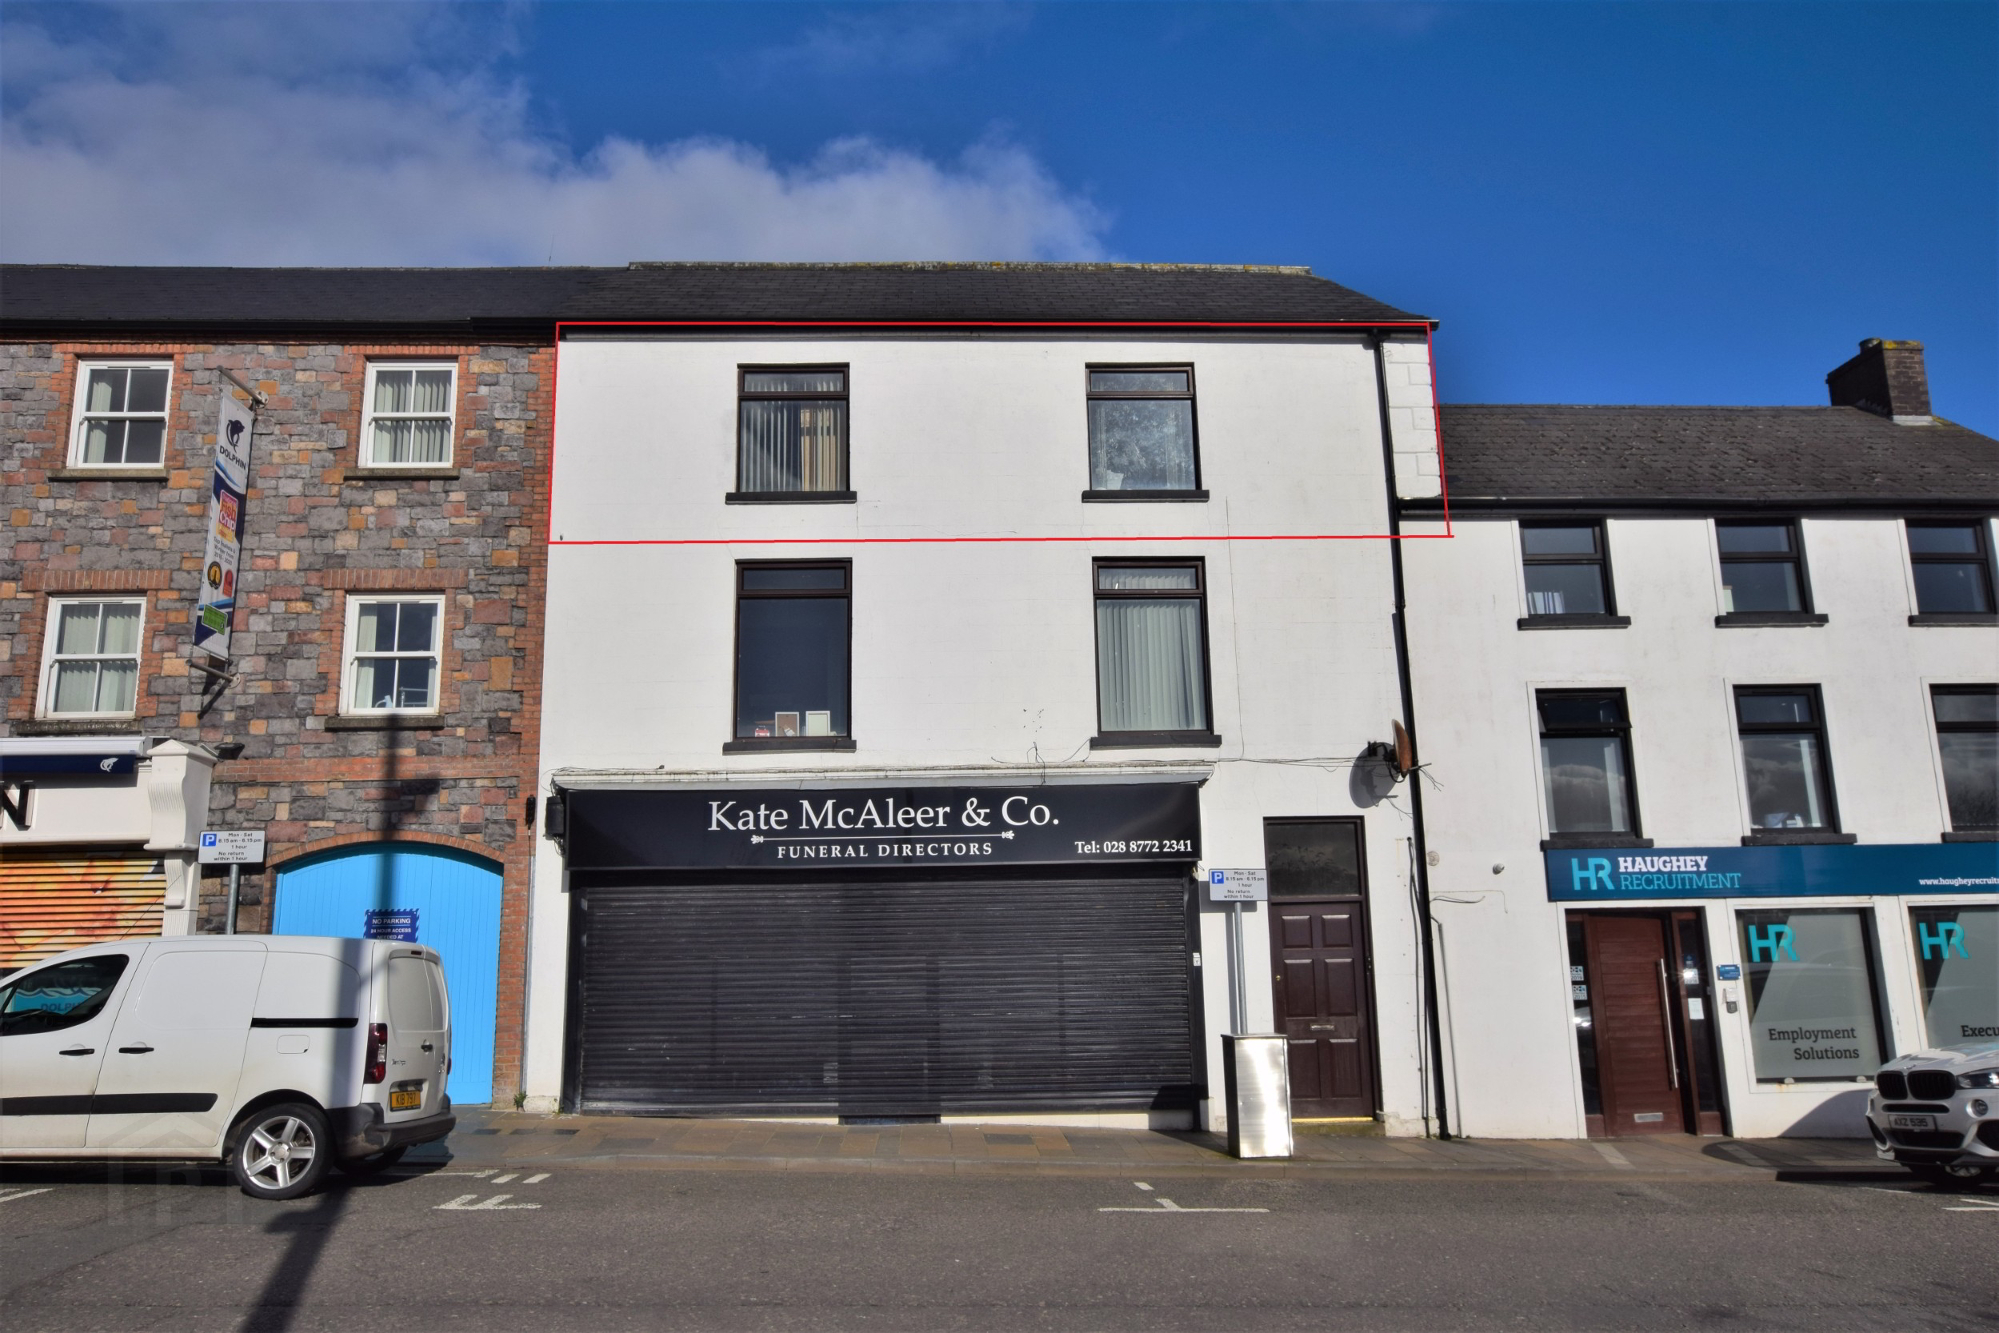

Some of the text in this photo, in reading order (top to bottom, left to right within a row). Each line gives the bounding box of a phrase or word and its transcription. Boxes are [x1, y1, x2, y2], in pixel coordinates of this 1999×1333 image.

[219, 445, 247, 471] DOLPHIN
[708, 796, 1060, 831] Kate McAleer & Co.
[777, 842, 993, 858] FUNERAL DIRECTORS
[1075, 840, 1193, 854] Tel: 028 8772 2341
[1618, 856, 1709, 873] HAUGHEY
[1571, 857, 1615, 891] HR
[1620, 873, 1741, 890] RECRUITMENT
[1748, 924, 1798, 962] HR
[1919, 922, 1970, 960] HR
[1768, 1027, 1857, 1043] Employment
[1794, 1047, 1860, 1060] Solutions
